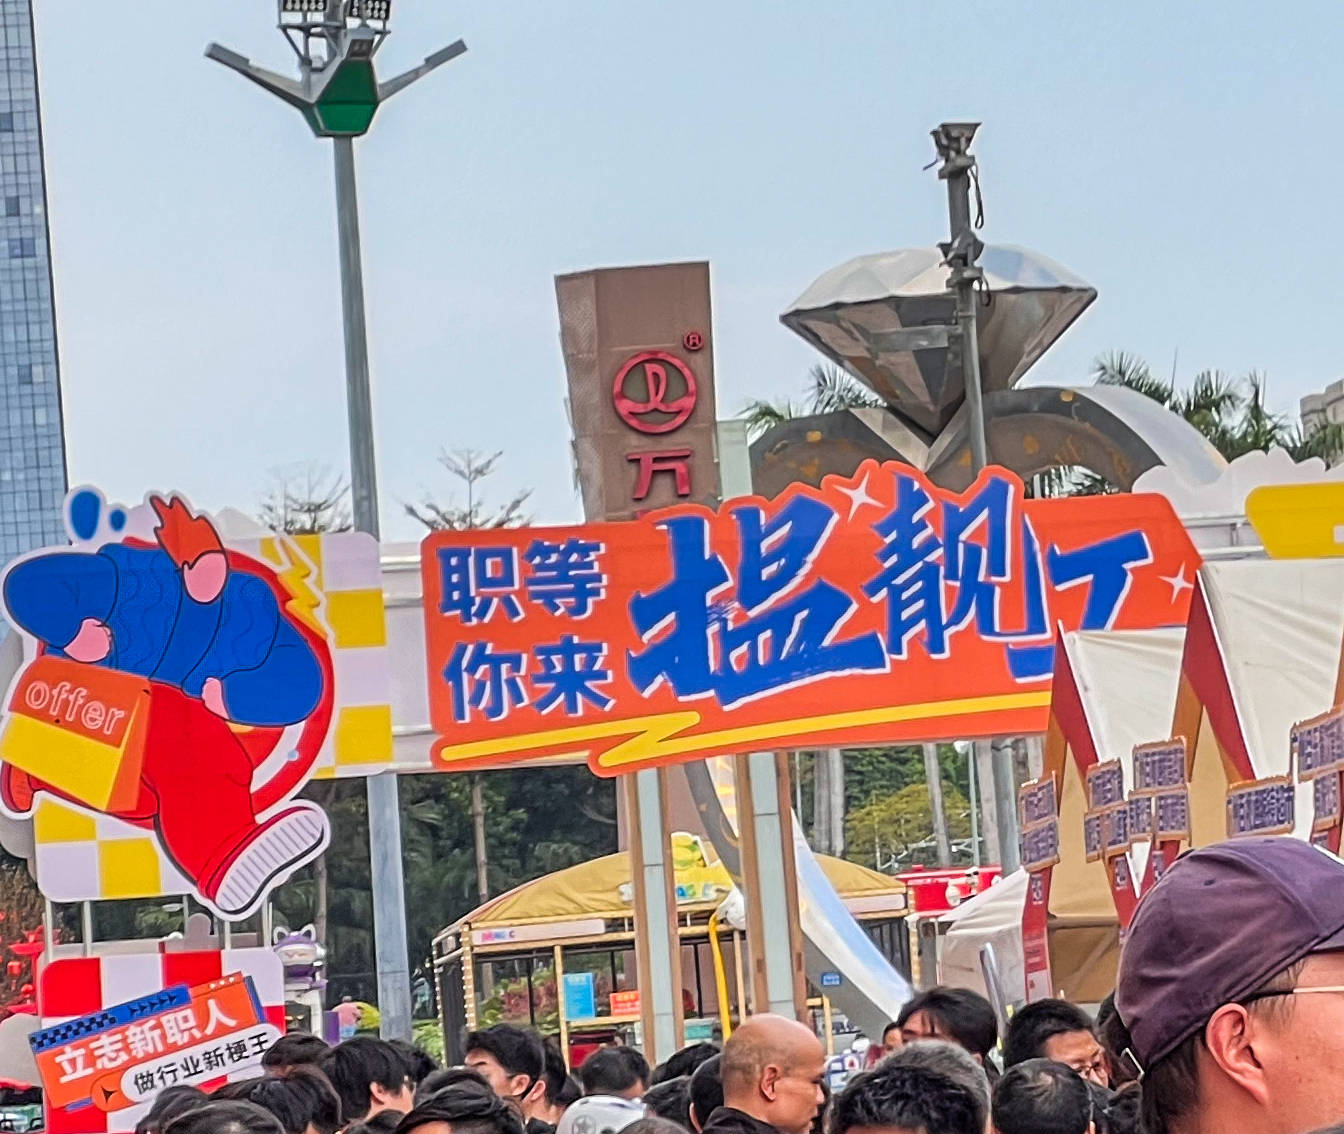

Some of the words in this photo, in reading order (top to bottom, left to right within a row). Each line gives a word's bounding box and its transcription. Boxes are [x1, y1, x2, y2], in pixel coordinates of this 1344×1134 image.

[437, 538, 606, 623] 职等
[25, 681, 124, 735] offer
[442, 635, 615, 721] 你来
[55, 998, 237, 1083] 立志新职人
[133, 1031, 271, 1095] 做行业新梗王
